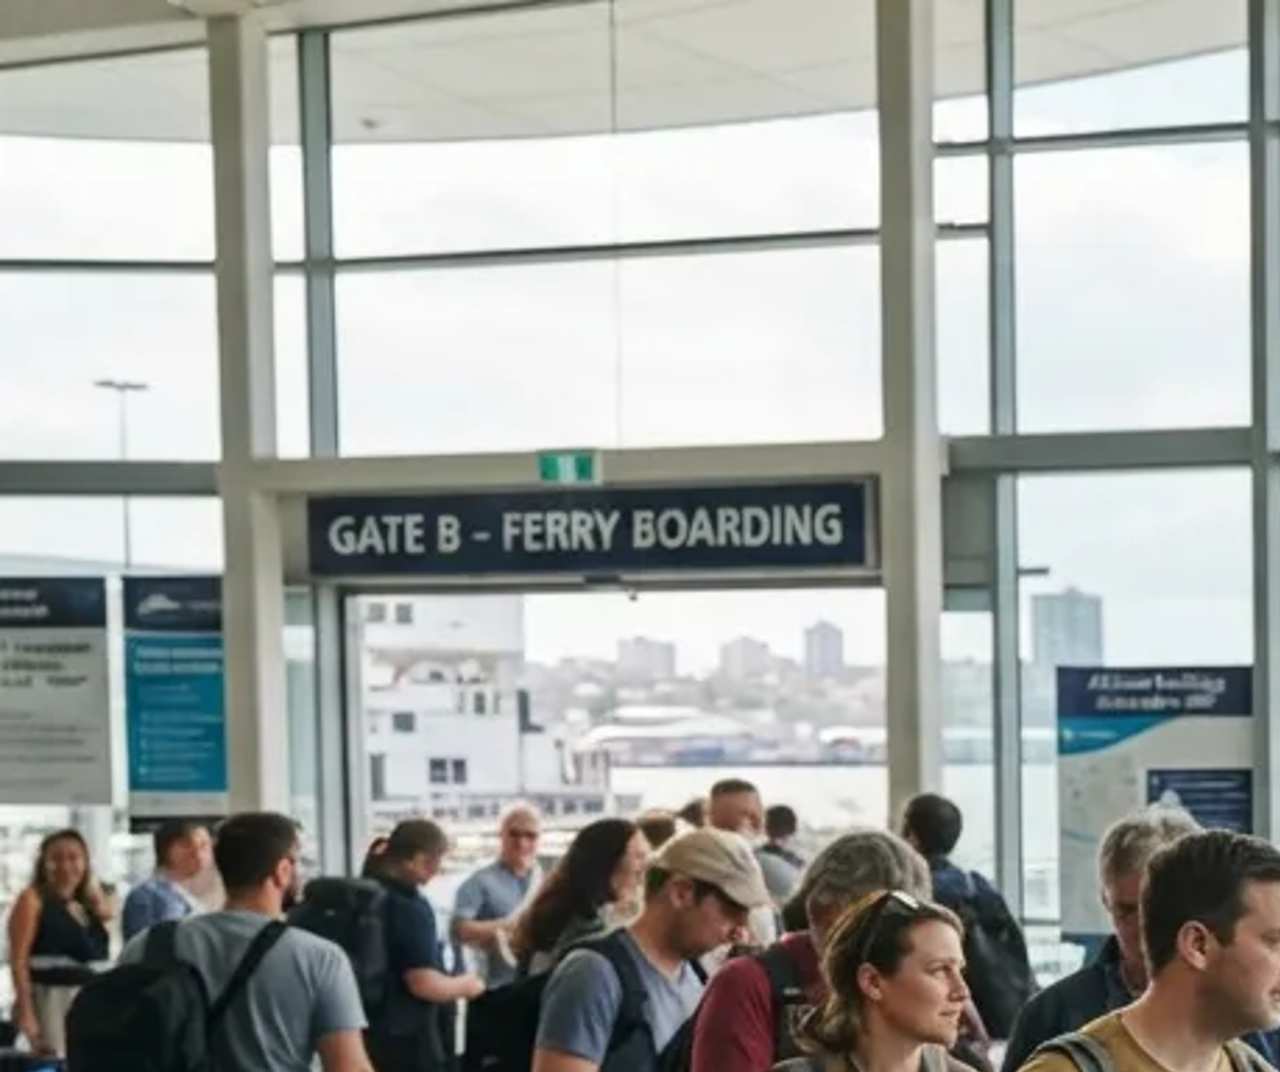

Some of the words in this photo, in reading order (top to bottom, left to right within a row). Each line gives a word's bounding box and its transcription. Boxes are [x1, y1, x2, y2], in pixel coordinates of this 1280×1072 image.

[328, 514, 425, 554] GATE
[437, 515, 461, 552] B
[503, 510, 621, 551] FERRY
[632, 503, 844, 548] BOARDING
